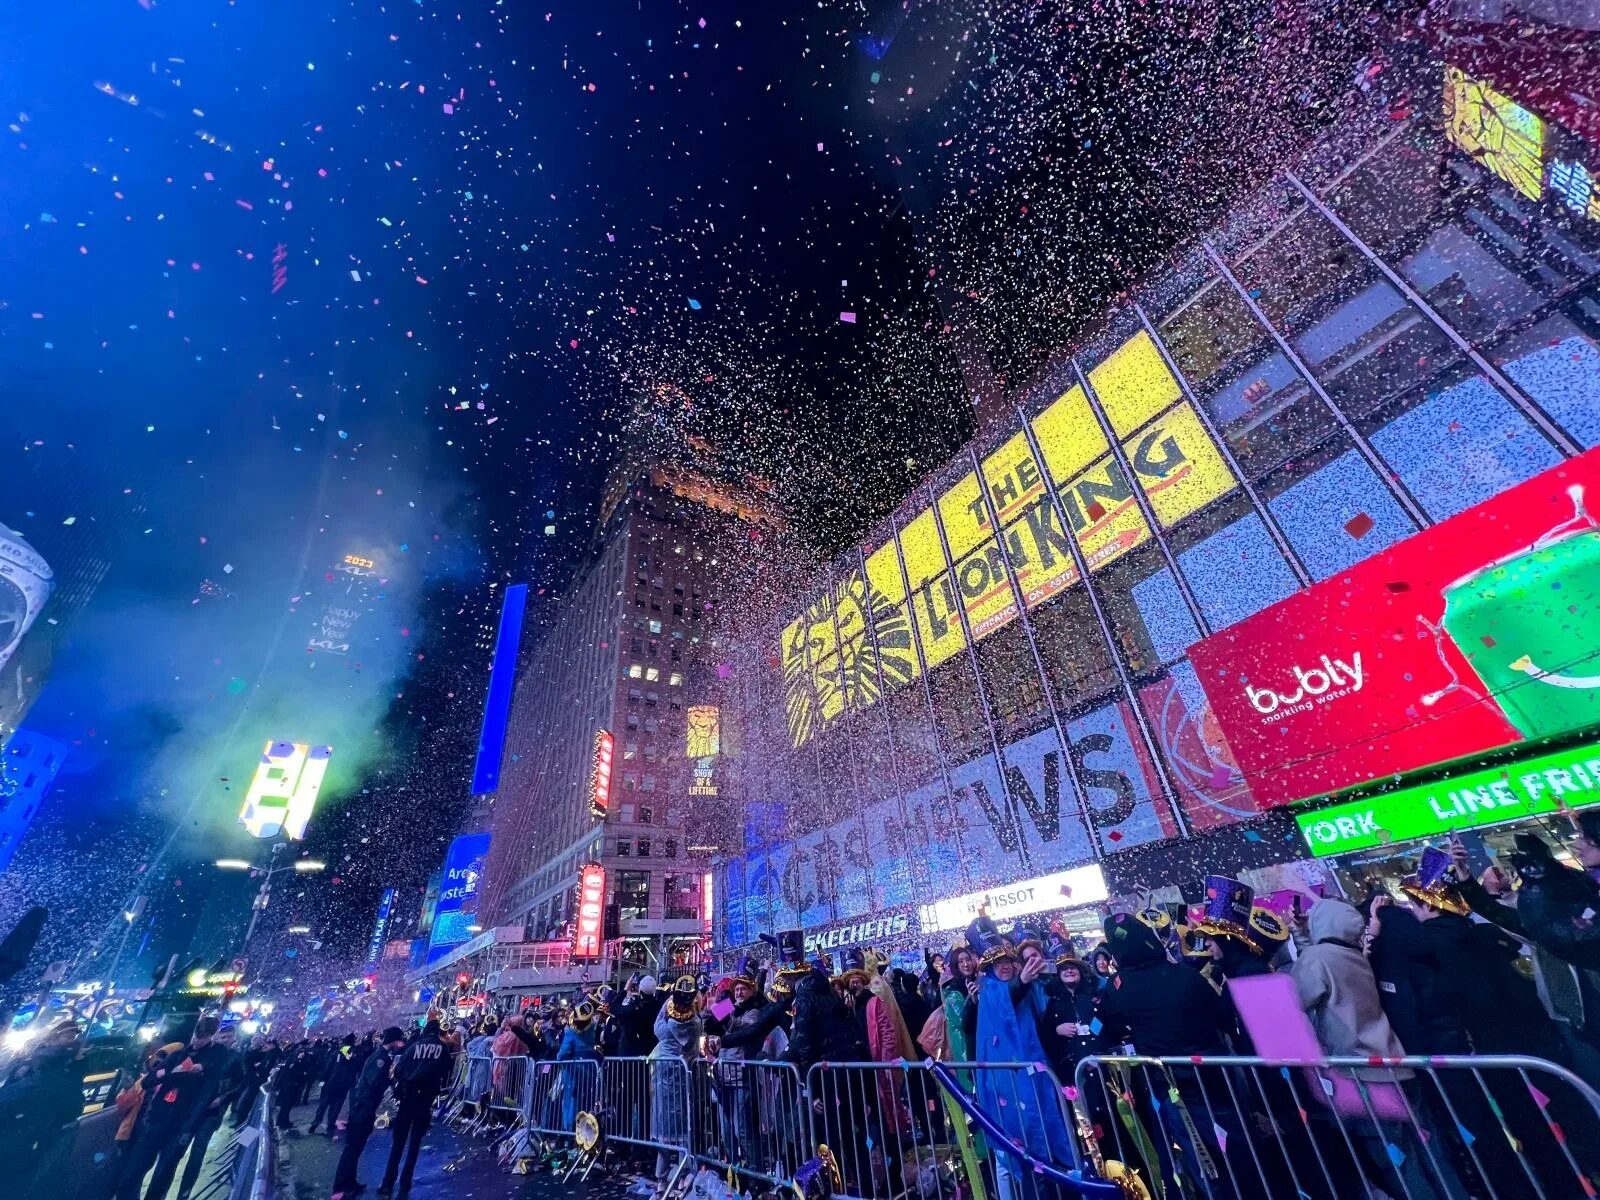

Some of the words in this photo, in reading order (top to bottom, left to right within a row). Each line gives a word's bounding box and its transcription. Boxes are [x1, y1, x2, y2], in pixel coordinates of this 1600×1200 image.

[1567, 161, 1592, 216] SHOW
[968, 457, 1041, 526] THE
[921, 531, 1029, 641] LION
[1026, 428, 1188, 571] KING
[344, 555, 374, 568] 2023
[1029, 589, 1044, 602] ON
[1245, 651, 1363, 714] bubly
[1261, 700, 1314, 725] sparkling
[1315, 686, 1352, 705] water
[688, 786, 719, 796] LIFETIME
[1427, 780, 1521, 821] LINE
[982, 887, 1035, 908] ISSOT
[804, 912, 908, 953] SKECHERS
[412, 1043, 443, 1060] NYPD
